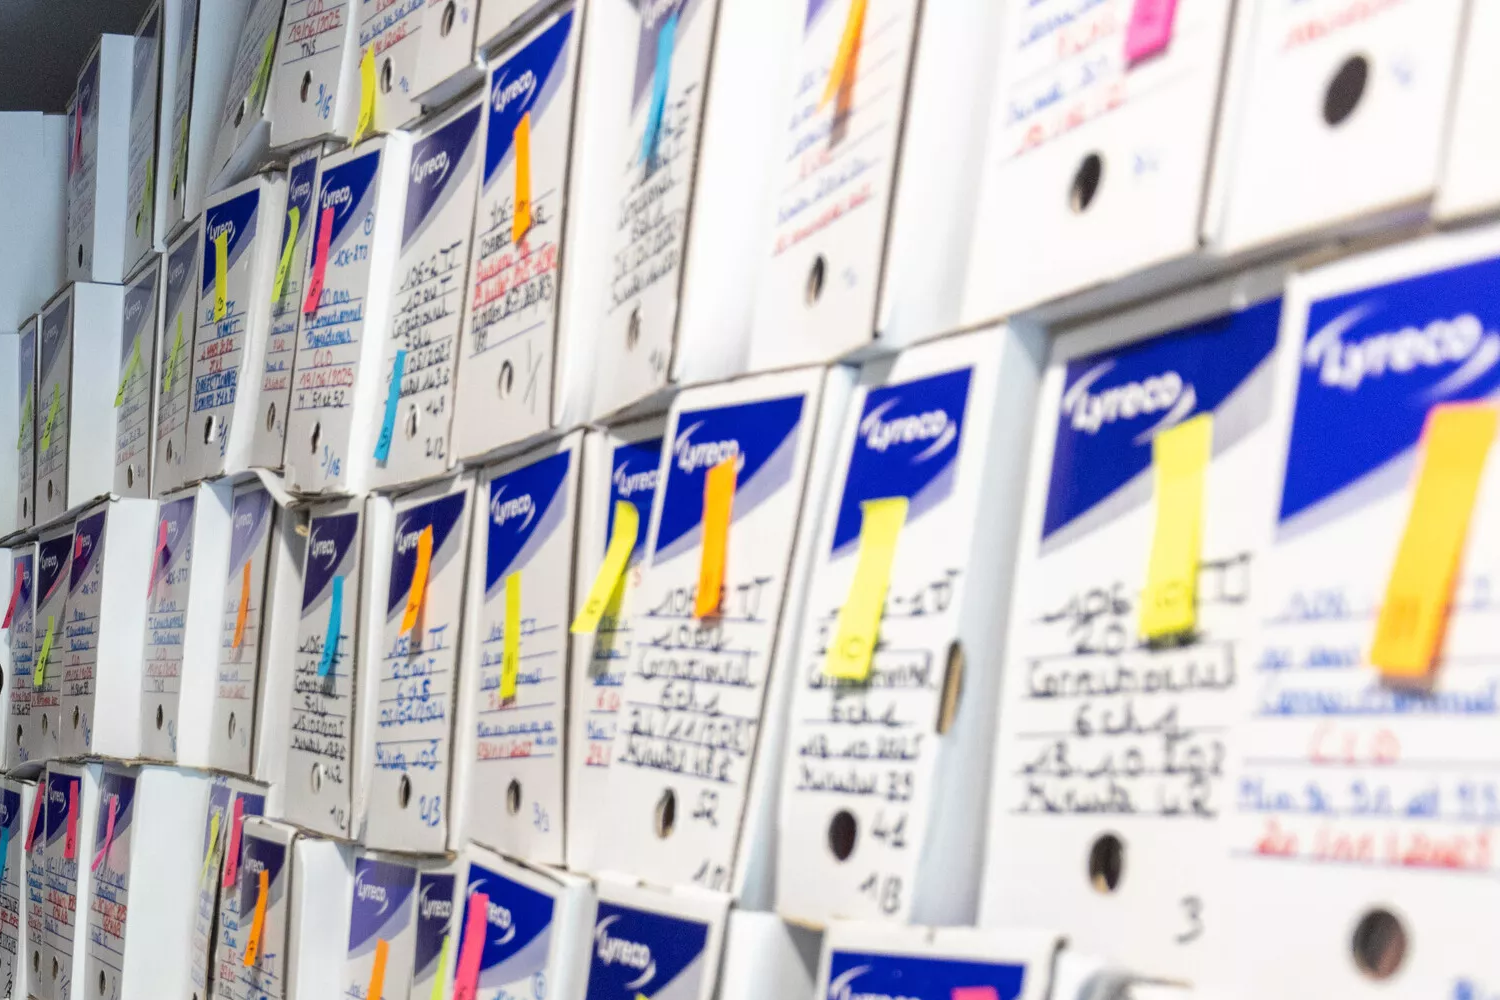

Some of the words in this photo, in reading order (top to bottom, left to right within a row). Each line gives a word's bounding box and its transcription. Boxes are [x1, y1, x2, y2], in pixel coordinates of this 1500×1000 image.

[494, 70, 533, 112] Lyreco
[413, 151, 448, 185] Lyreco
[322, 187, 350, 208] Lyreco
[209, 219, 233, 241] Lyreco
[1318, 314, 1485, 391] Lyreco
[1072, 372, 1182, 434] Lyreco
[867, 408, 948, 451] Lyreco
[677, 440, 740, 473] Lyreco
[493, 492, 531, 524] Lyreco
[312, 535, 334, 556] Lyreco
[41, 554, 57, 570] Lyreco
[244, 858, 265, 874] Lyreco
[357, 875, 386, 903] Lyreco
[422, 895, 453, 918] Lyreco
[598, 932, 650, 972] Lyreco
